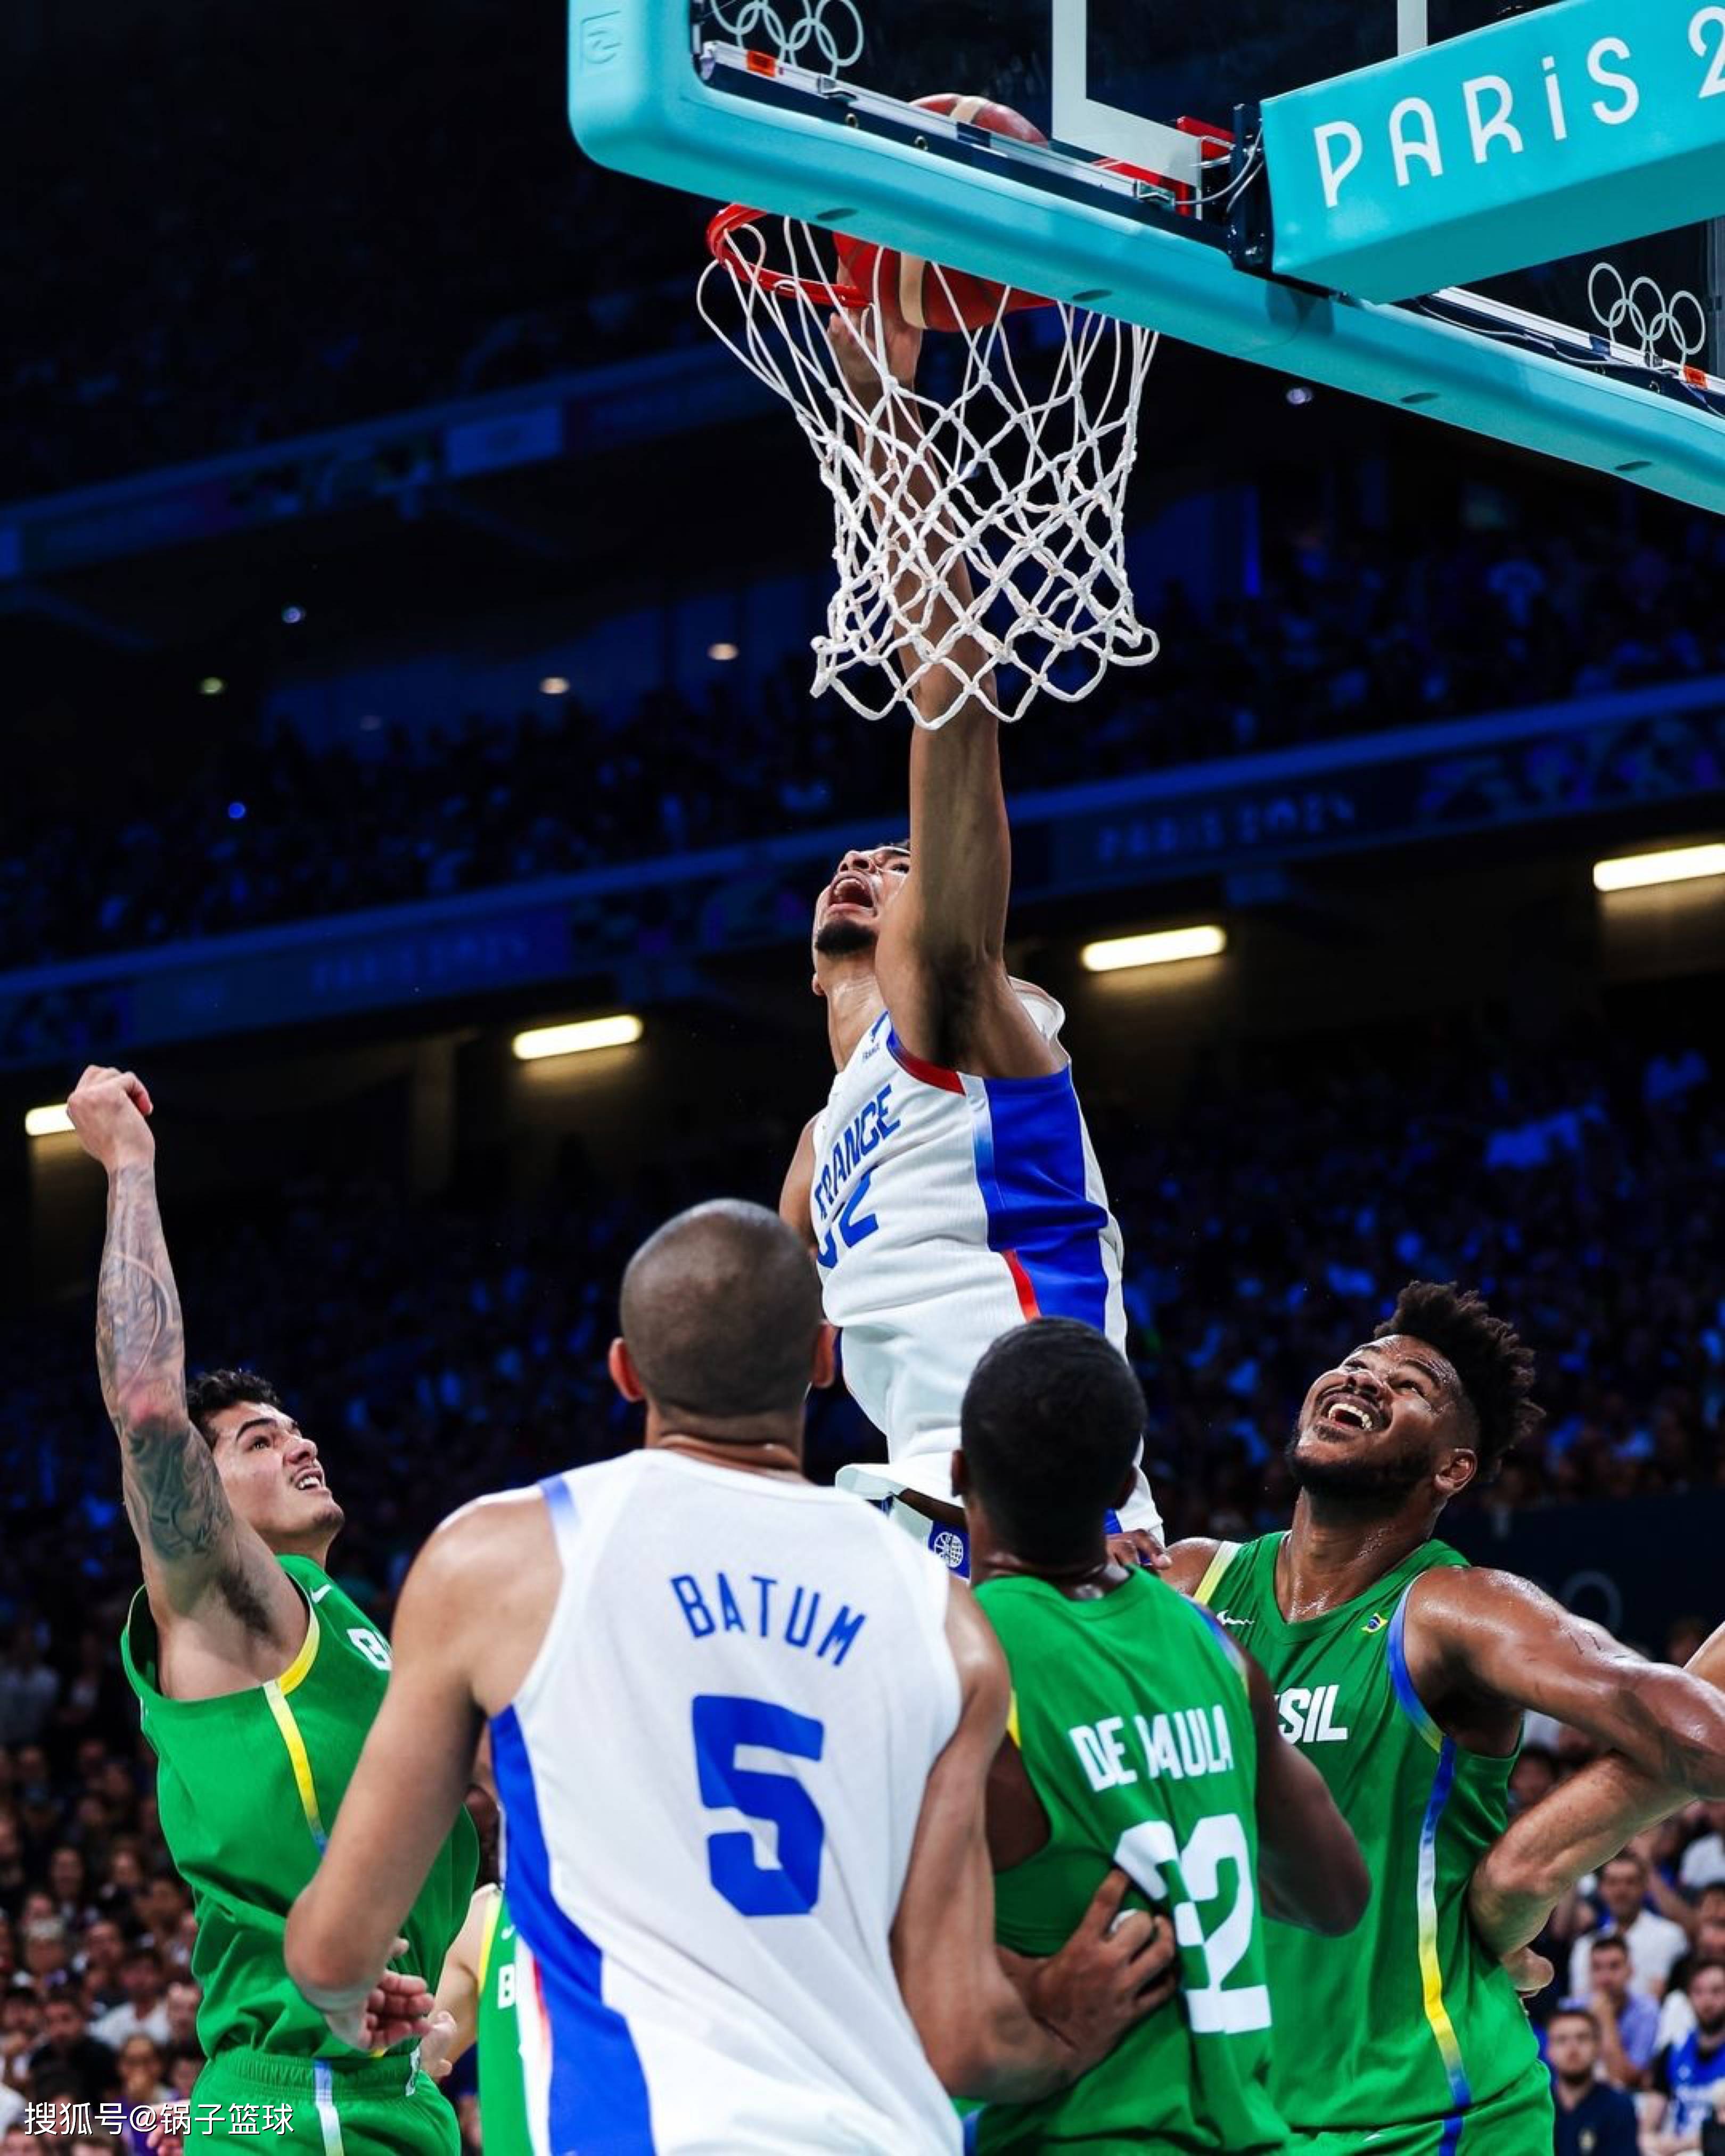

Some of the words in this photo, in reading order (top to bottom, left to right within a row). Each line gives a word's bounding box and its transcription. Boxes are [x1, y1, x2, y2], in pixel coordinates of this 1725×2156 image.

[814, 1083, 901, 1221] FRANCE
[670, 1572, 867, 1667] BATUM
[1069, 1716, 1137, 1792] DE
[1275, 1689, 1348, 1745] SIL
[692, 1694, 825, 1916] 5
